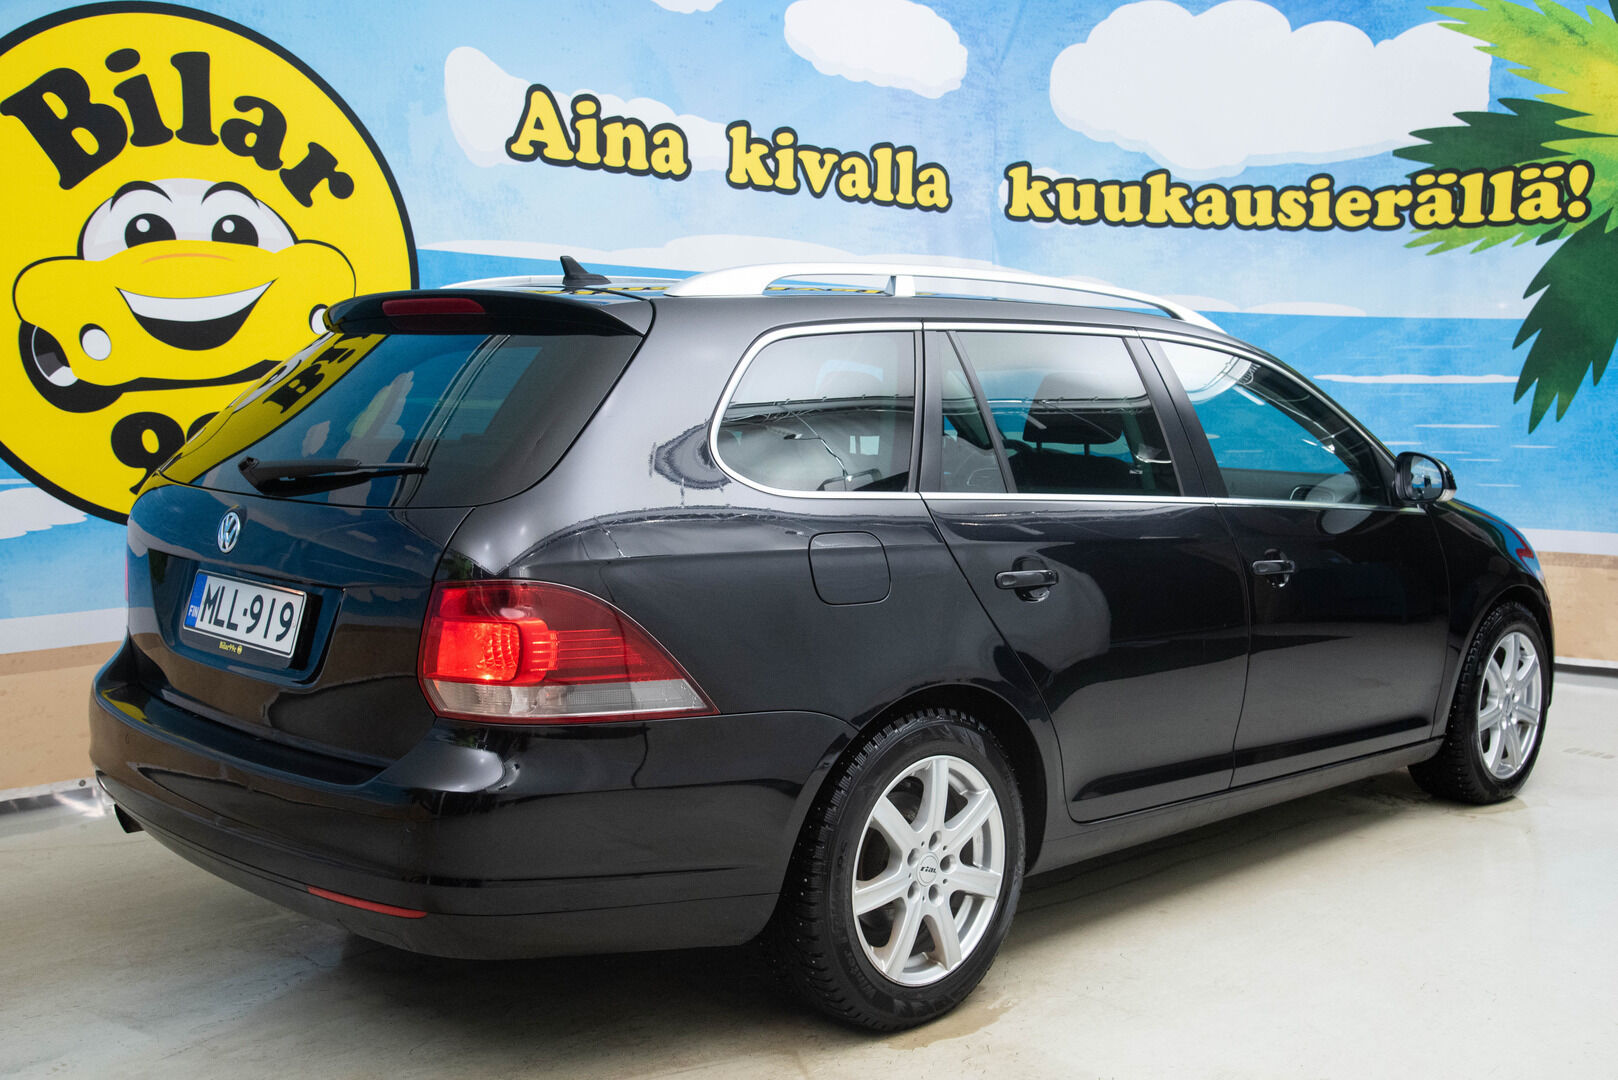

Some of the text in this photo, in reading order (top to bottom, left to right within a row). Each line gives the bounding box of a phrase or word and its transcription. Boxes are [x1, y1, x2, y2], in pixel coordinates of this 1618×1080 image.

[0, 48, 354, 207] Bilar
[507, 84, 1592, 231] Aina kivalla kuukausierällä!
[188, 605, 200, 618] FIN
[200, 583, 295, 642] MLL-919
